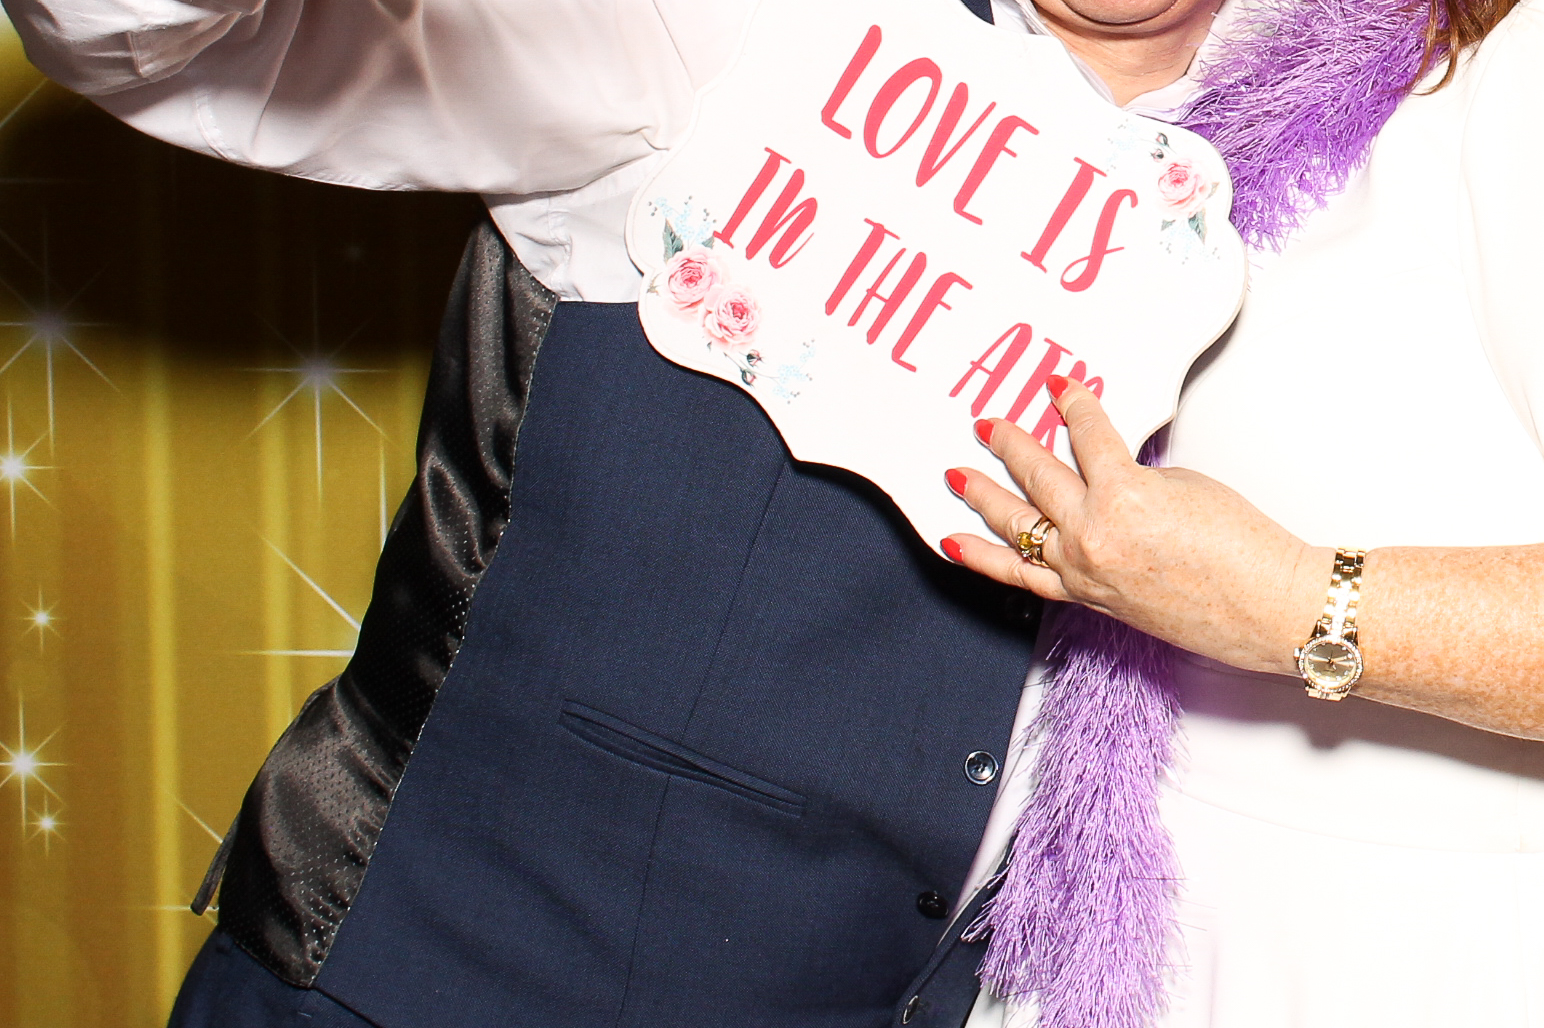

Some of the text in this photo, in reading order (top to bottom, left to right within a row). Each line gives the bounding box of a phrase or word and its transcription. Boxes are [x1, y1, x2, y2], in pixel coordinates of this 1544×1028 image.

[713, 147, 818, 269] IN
[825, 218, 973, 373] THE
[821, 24, 1138, 293] LOVE IS
